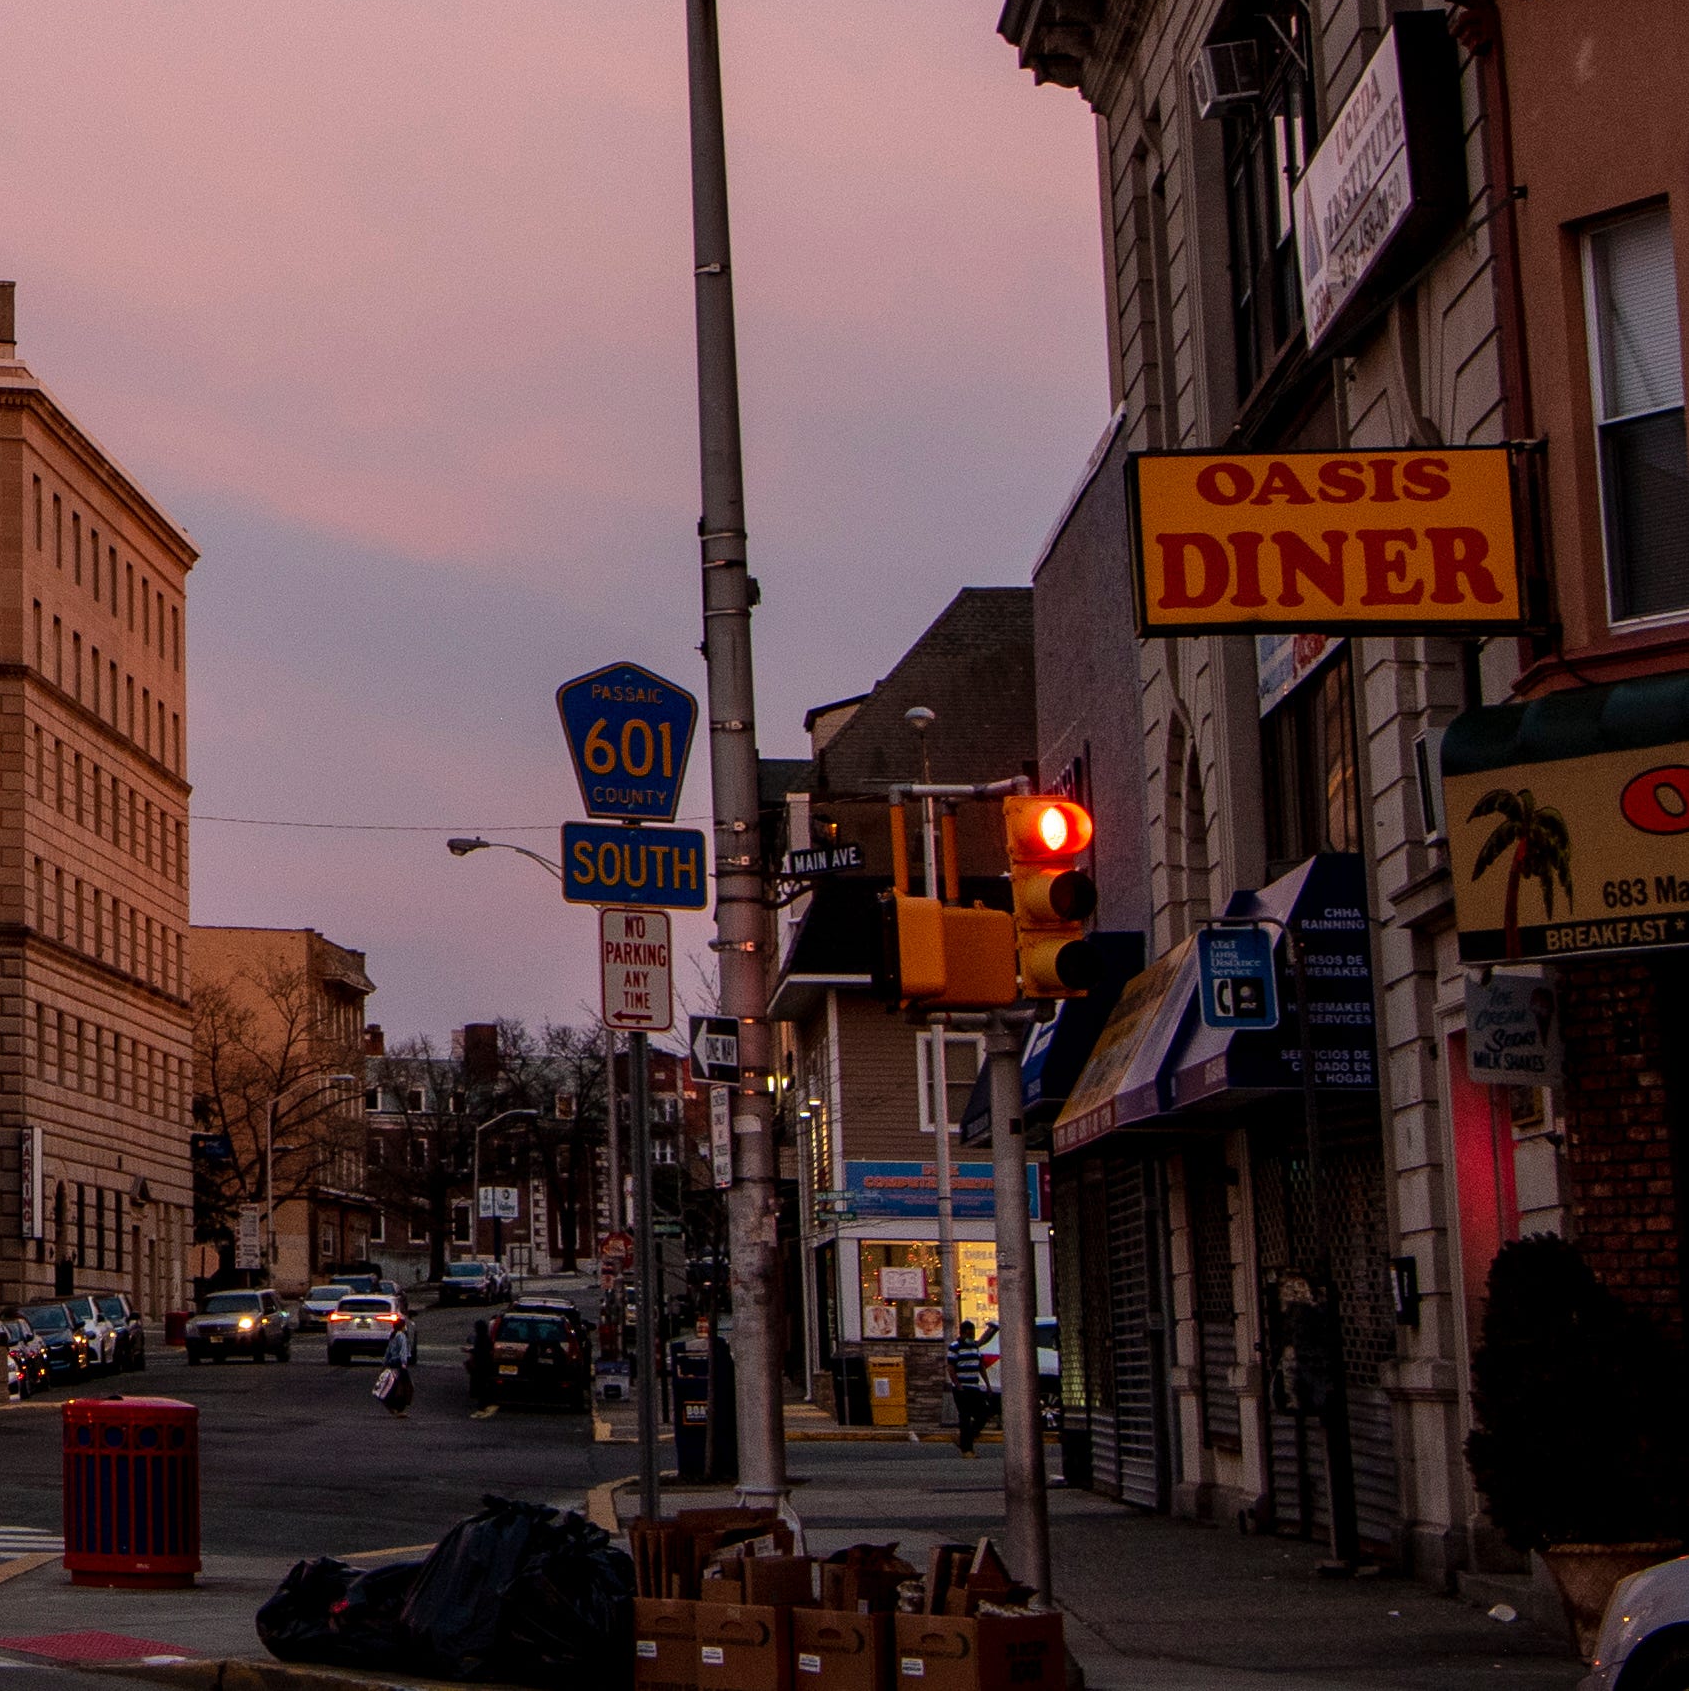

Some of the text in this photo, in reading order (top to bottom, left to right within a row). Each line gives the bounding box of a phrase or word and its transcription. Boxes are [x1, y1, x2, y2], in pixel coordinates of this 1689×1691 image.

[1335, 67, 1383, 167] UCEDA
[1323, 93, 1401, 241] INSTITUTE
[1196, 458, 1451, 506] OASIS
[1156, 527, 1504, 610] DINER
[592, 684, 663, 705] PASSAIC
[582, 716, 673, 779] 601
[592, 785, 668, 807] COUNTY
[572, 839, 698, 891] SOUTH
[794, 850, 827, 874] MAIN
[1602, 877, 1648, 909] 683
[624, 915, 646, 939] NO
[1545, 918, 1669, 951] BREAKFAST
[605, 942, 667, 968] PARKING
[1210, 958, 1262, 967] Distance
[1345, 954, 1364, 966] DE
[624, 971, 649, 990] ANY
[1210, 967, 1253, 977] Service
[1284, 965, 1369, 978] HMEMAKER
[623, 990, 651, 1010] TIME
[1286, 1001, 1371, 1013] HMEMAKER
[1308, 1013, 1372, 1025] SERVICES
[1353, 1049, 1372, 1061] DE
[1474, 1051, 1502, 1069] MILK
[1291, 1061, 1372, 1072] CDADO EN
[1326, 1073, 1372, 1084] HOGAR
[22, 1131, 32, 1223] PARKING
